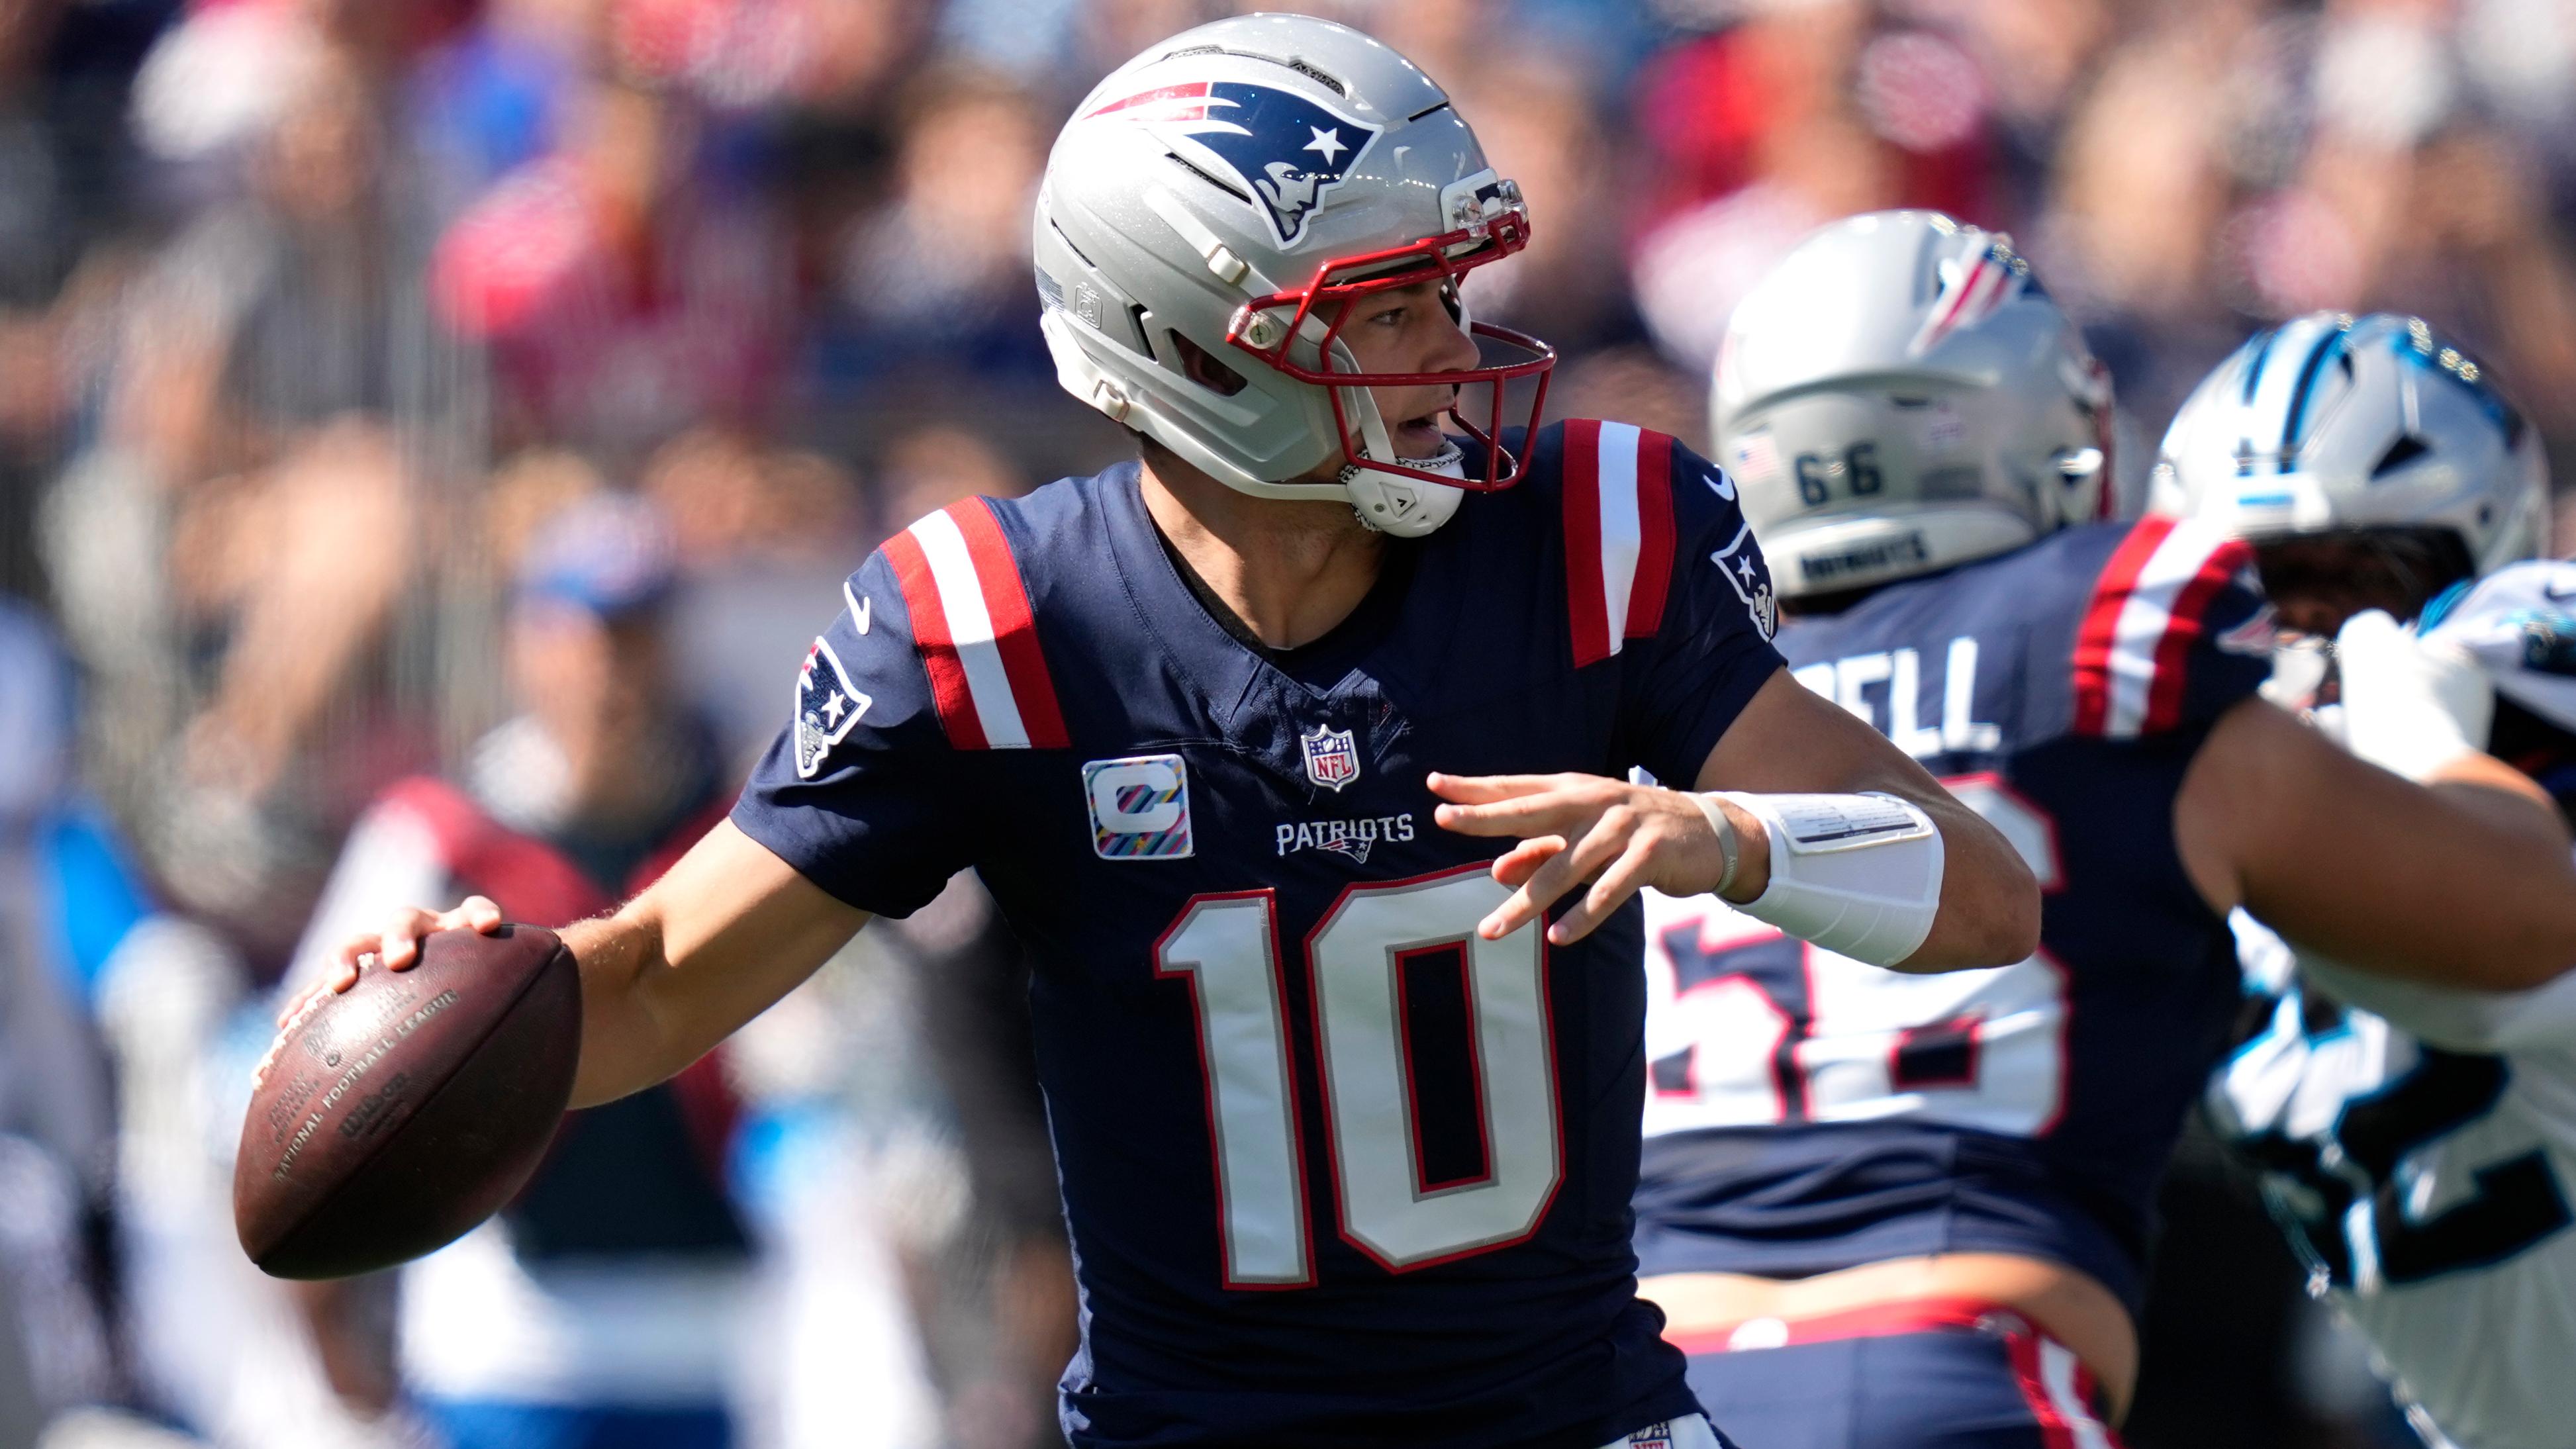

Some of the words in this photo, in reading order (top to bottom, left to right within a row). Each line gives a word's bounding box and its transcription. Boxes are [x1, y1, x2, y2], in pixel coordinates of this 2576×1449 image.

[1794, 442, 1880, 507] 66
[1091, 763, 1182, 834] C
[1315, 754, 1351, 779] NFL
[1276, 813, 1415, 857] PATRIOTS
[272, 1113, 324, 1184] NATIONAL
[322, 1037, 396, 1109] FOOTBALL
[395, 989, 459, 1039] LEAGUE
[1152, 859, 1566, 1291] 10
